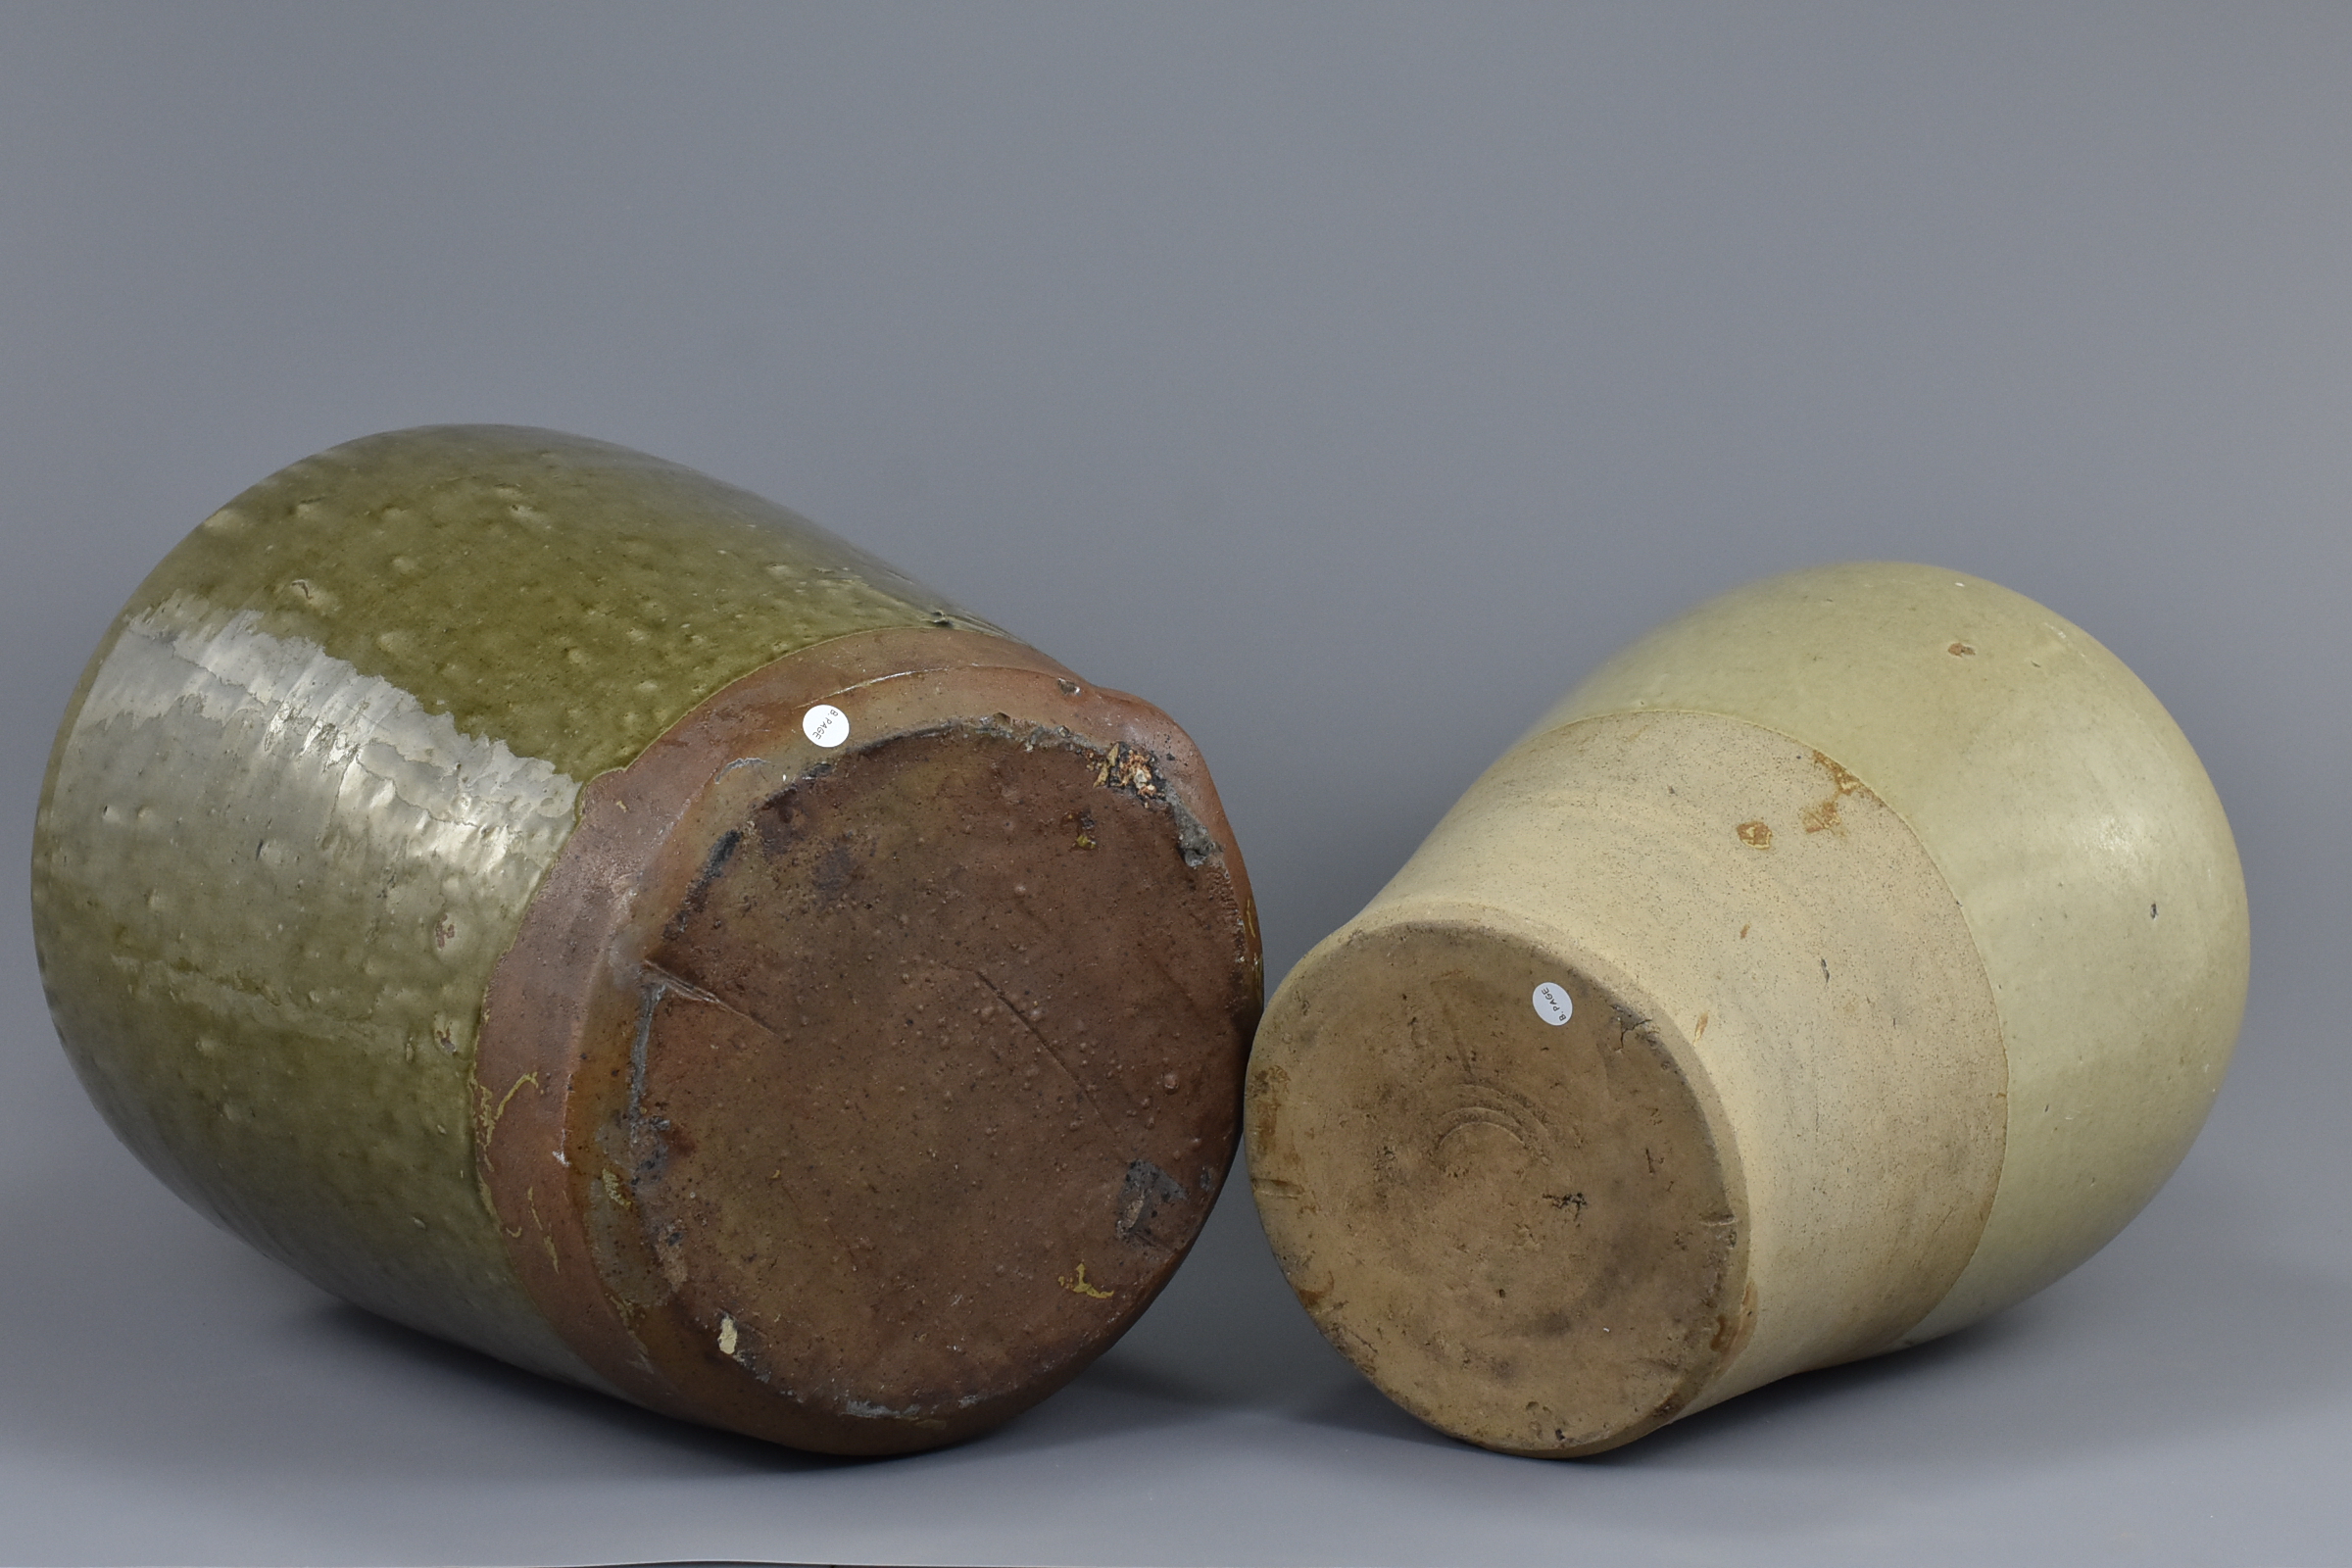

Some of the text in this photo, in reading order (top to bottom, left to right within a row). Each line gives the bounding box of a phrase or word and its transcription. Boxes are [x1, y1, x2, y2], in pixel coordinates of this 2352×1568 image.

[812, 716, 833, 740] PAGE
[1541, 987, 1567, 1021] B. PAGE
